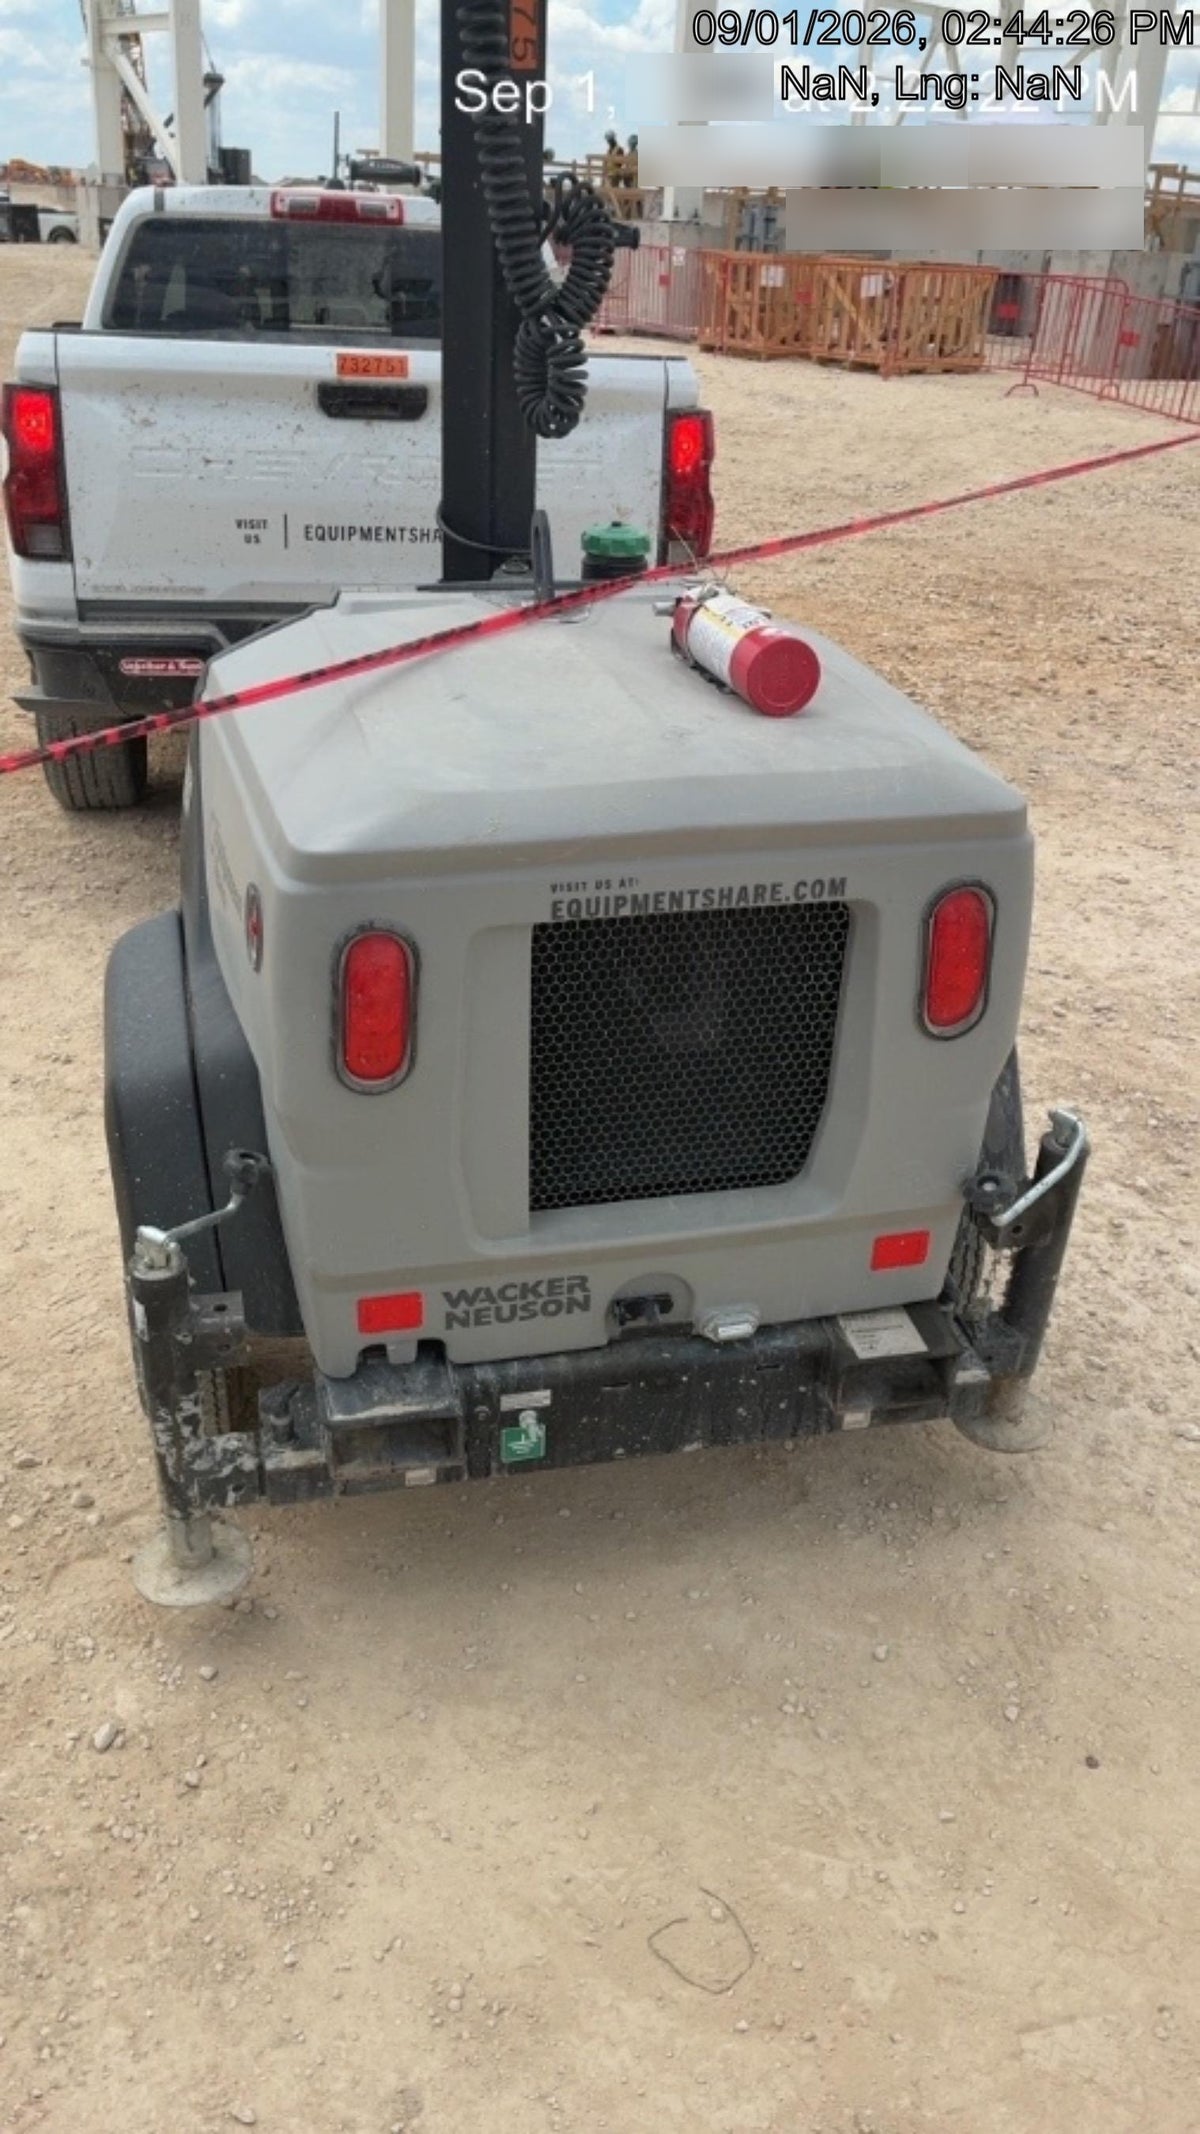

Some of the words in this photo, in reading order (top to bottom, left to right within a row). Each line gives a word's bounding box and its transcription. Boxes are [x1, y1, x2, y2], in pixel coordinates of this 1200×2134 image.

[235, 518, 268, 530] VISIT
[304, 523, 442, 544] EQUIPMENTSHA
[244, 533, 261, 545] US
[550, 881, 588, 894] VISIT
[594, 879, 612, 891] US
[551, 876, 848, 921] EQUIPMENTSHARE.COM
[442, 1275, 592, 1309] WACKER
[445, 1293, 592, 1331] NEUSON
